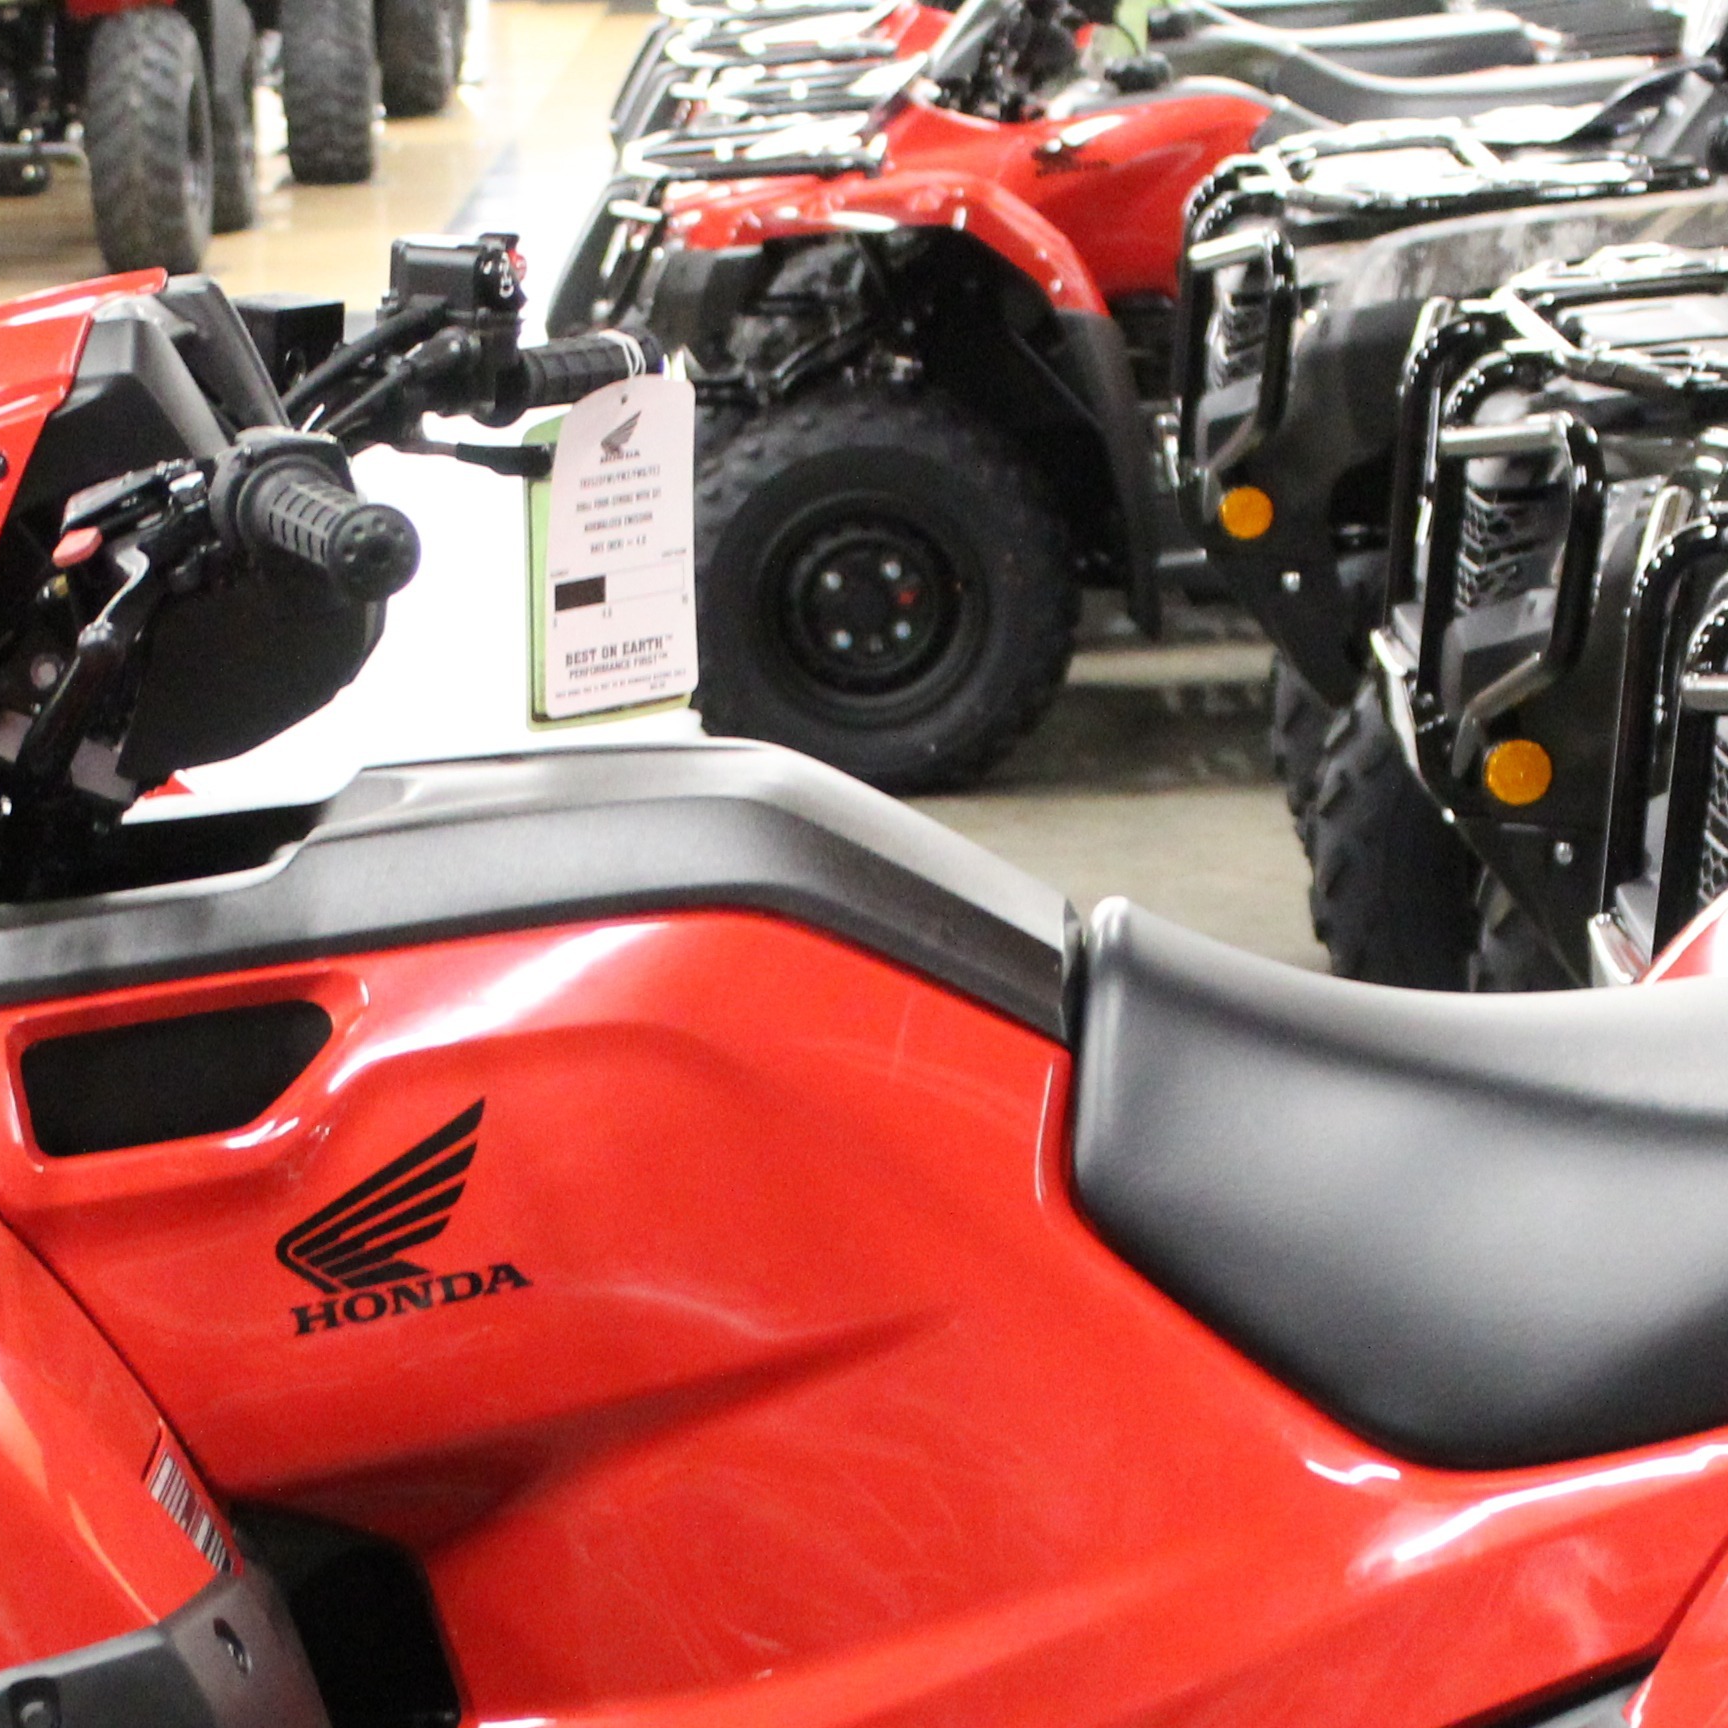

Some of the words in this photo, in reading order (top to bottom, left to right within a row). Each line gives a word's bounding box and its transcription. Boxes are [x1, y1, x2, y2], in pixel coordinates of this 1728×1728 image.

[565, 646, 598, 668] BEST
[602, 642, 618, 660] ON
[568, 657, 632, 680] PERFORMANCE
[289, 1263, 535, 1338] HONDA
